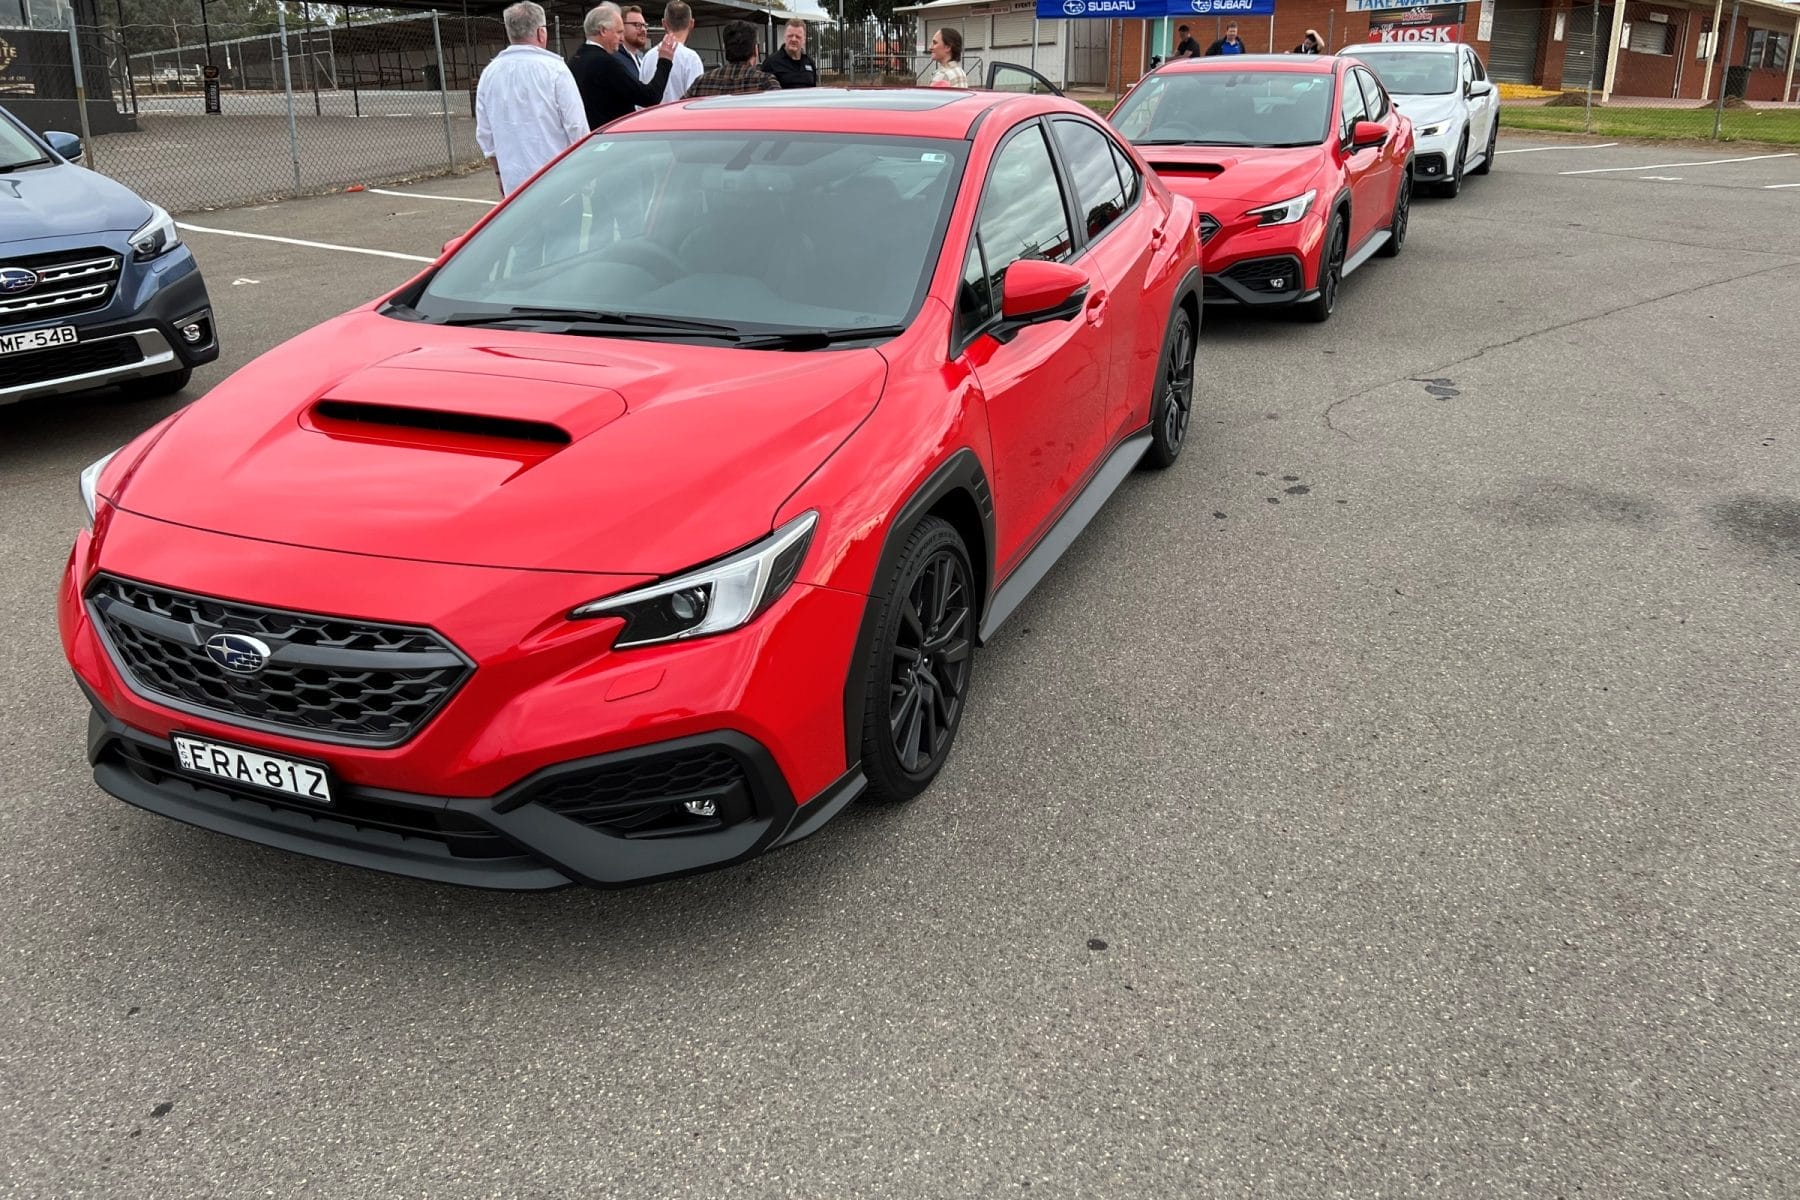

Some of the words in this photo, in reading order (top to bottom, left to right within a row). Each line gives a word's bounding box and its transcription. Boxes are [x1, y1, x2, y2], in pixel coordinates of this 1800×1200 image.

[1088, 0, 1136, 12] SUBARU
[1213, 0, 1253, 10] SUBARU
[1381, 26, 1452, 43] KIOSK
